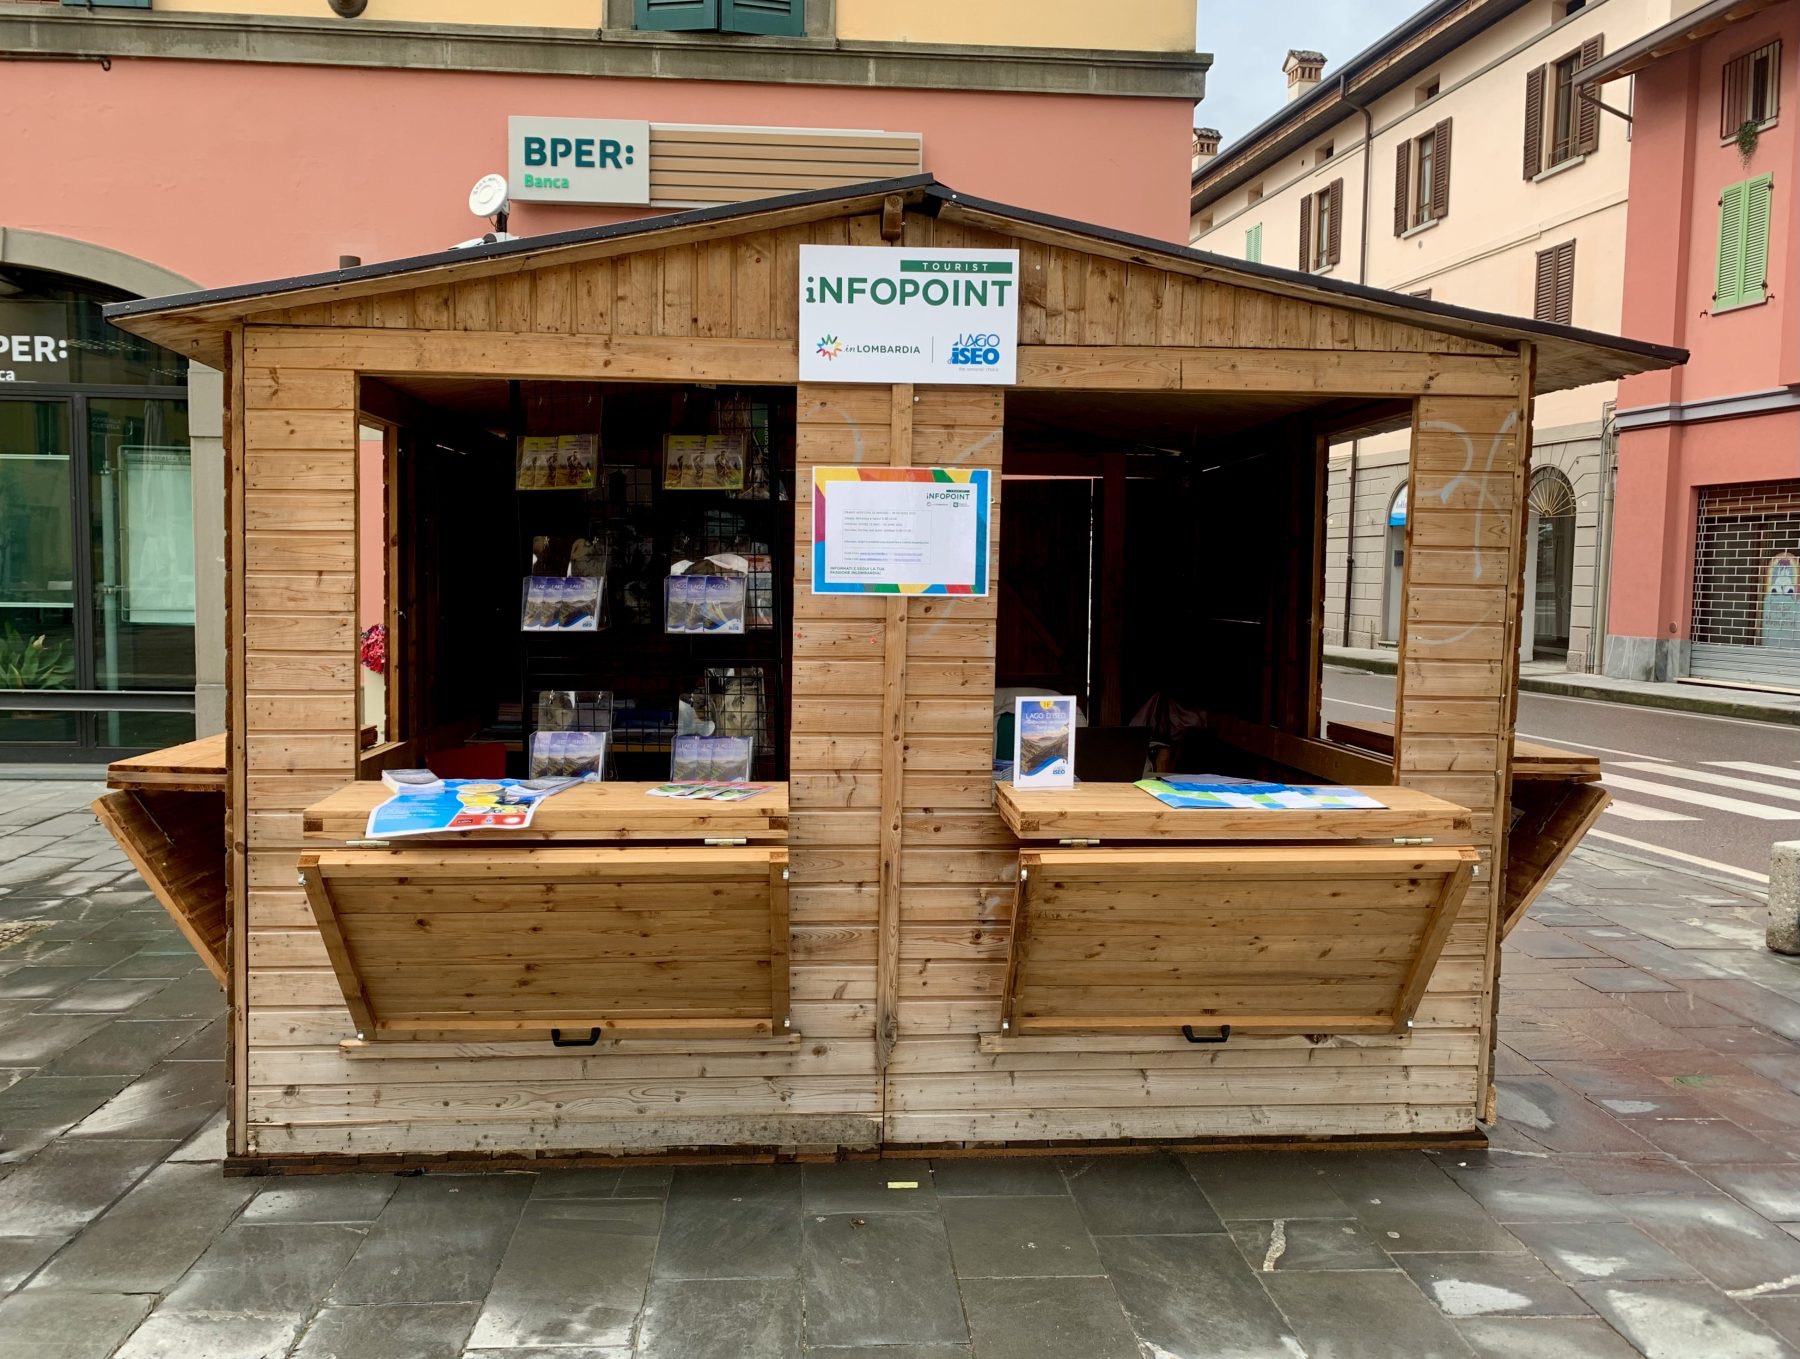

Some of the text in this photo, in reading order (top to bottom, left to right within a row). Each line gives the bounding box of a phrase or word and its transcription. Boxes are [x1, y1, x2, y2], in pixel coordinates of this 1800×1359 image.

[524, 136, 634, 169] BPER:
[524, 174, 569, 189] Banca
[922, 262, 988, 271] TOURIST
[960, 333, 1000, 347] LAGO
[1025, 712, 1044, 720] LAGO
